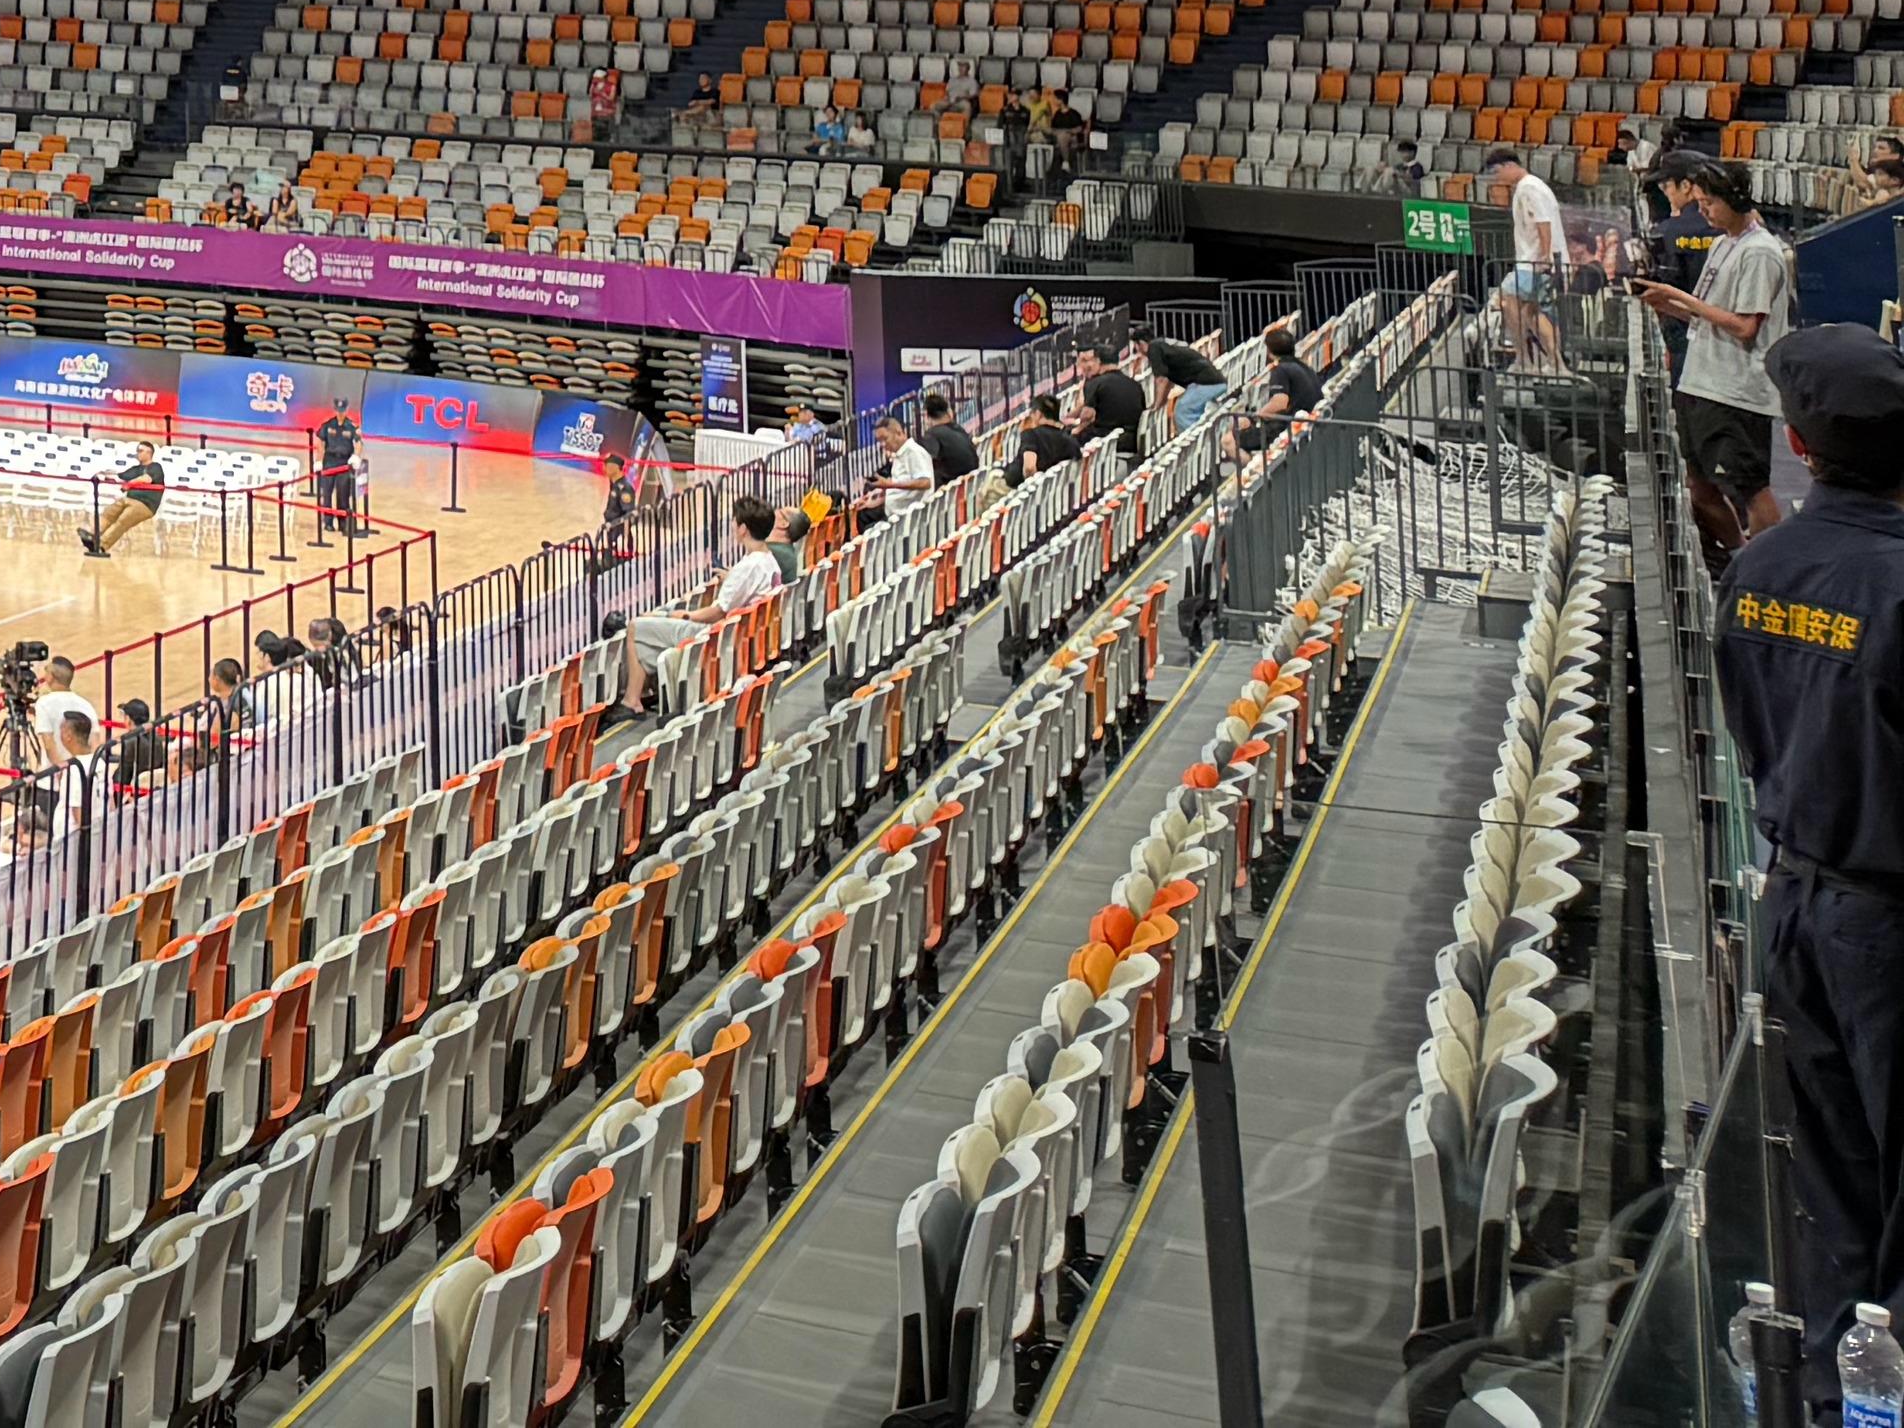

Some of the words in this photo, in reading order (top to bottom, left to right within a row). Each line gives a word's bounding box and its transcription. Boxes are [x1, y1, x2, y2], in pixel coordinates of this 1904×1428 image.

[1408, 210, 1436, 240] 2号
[2, 244, 81, 263] International
[85, 250, 145, 269] Solidarity
[149, 255, 175, 271] Cup
[417, 277, 492, 297] International
[496, 284, 552, 305] Solidarity
[555, 289, 580, 308] Cup
[406, 394, 489, 432] TCL
